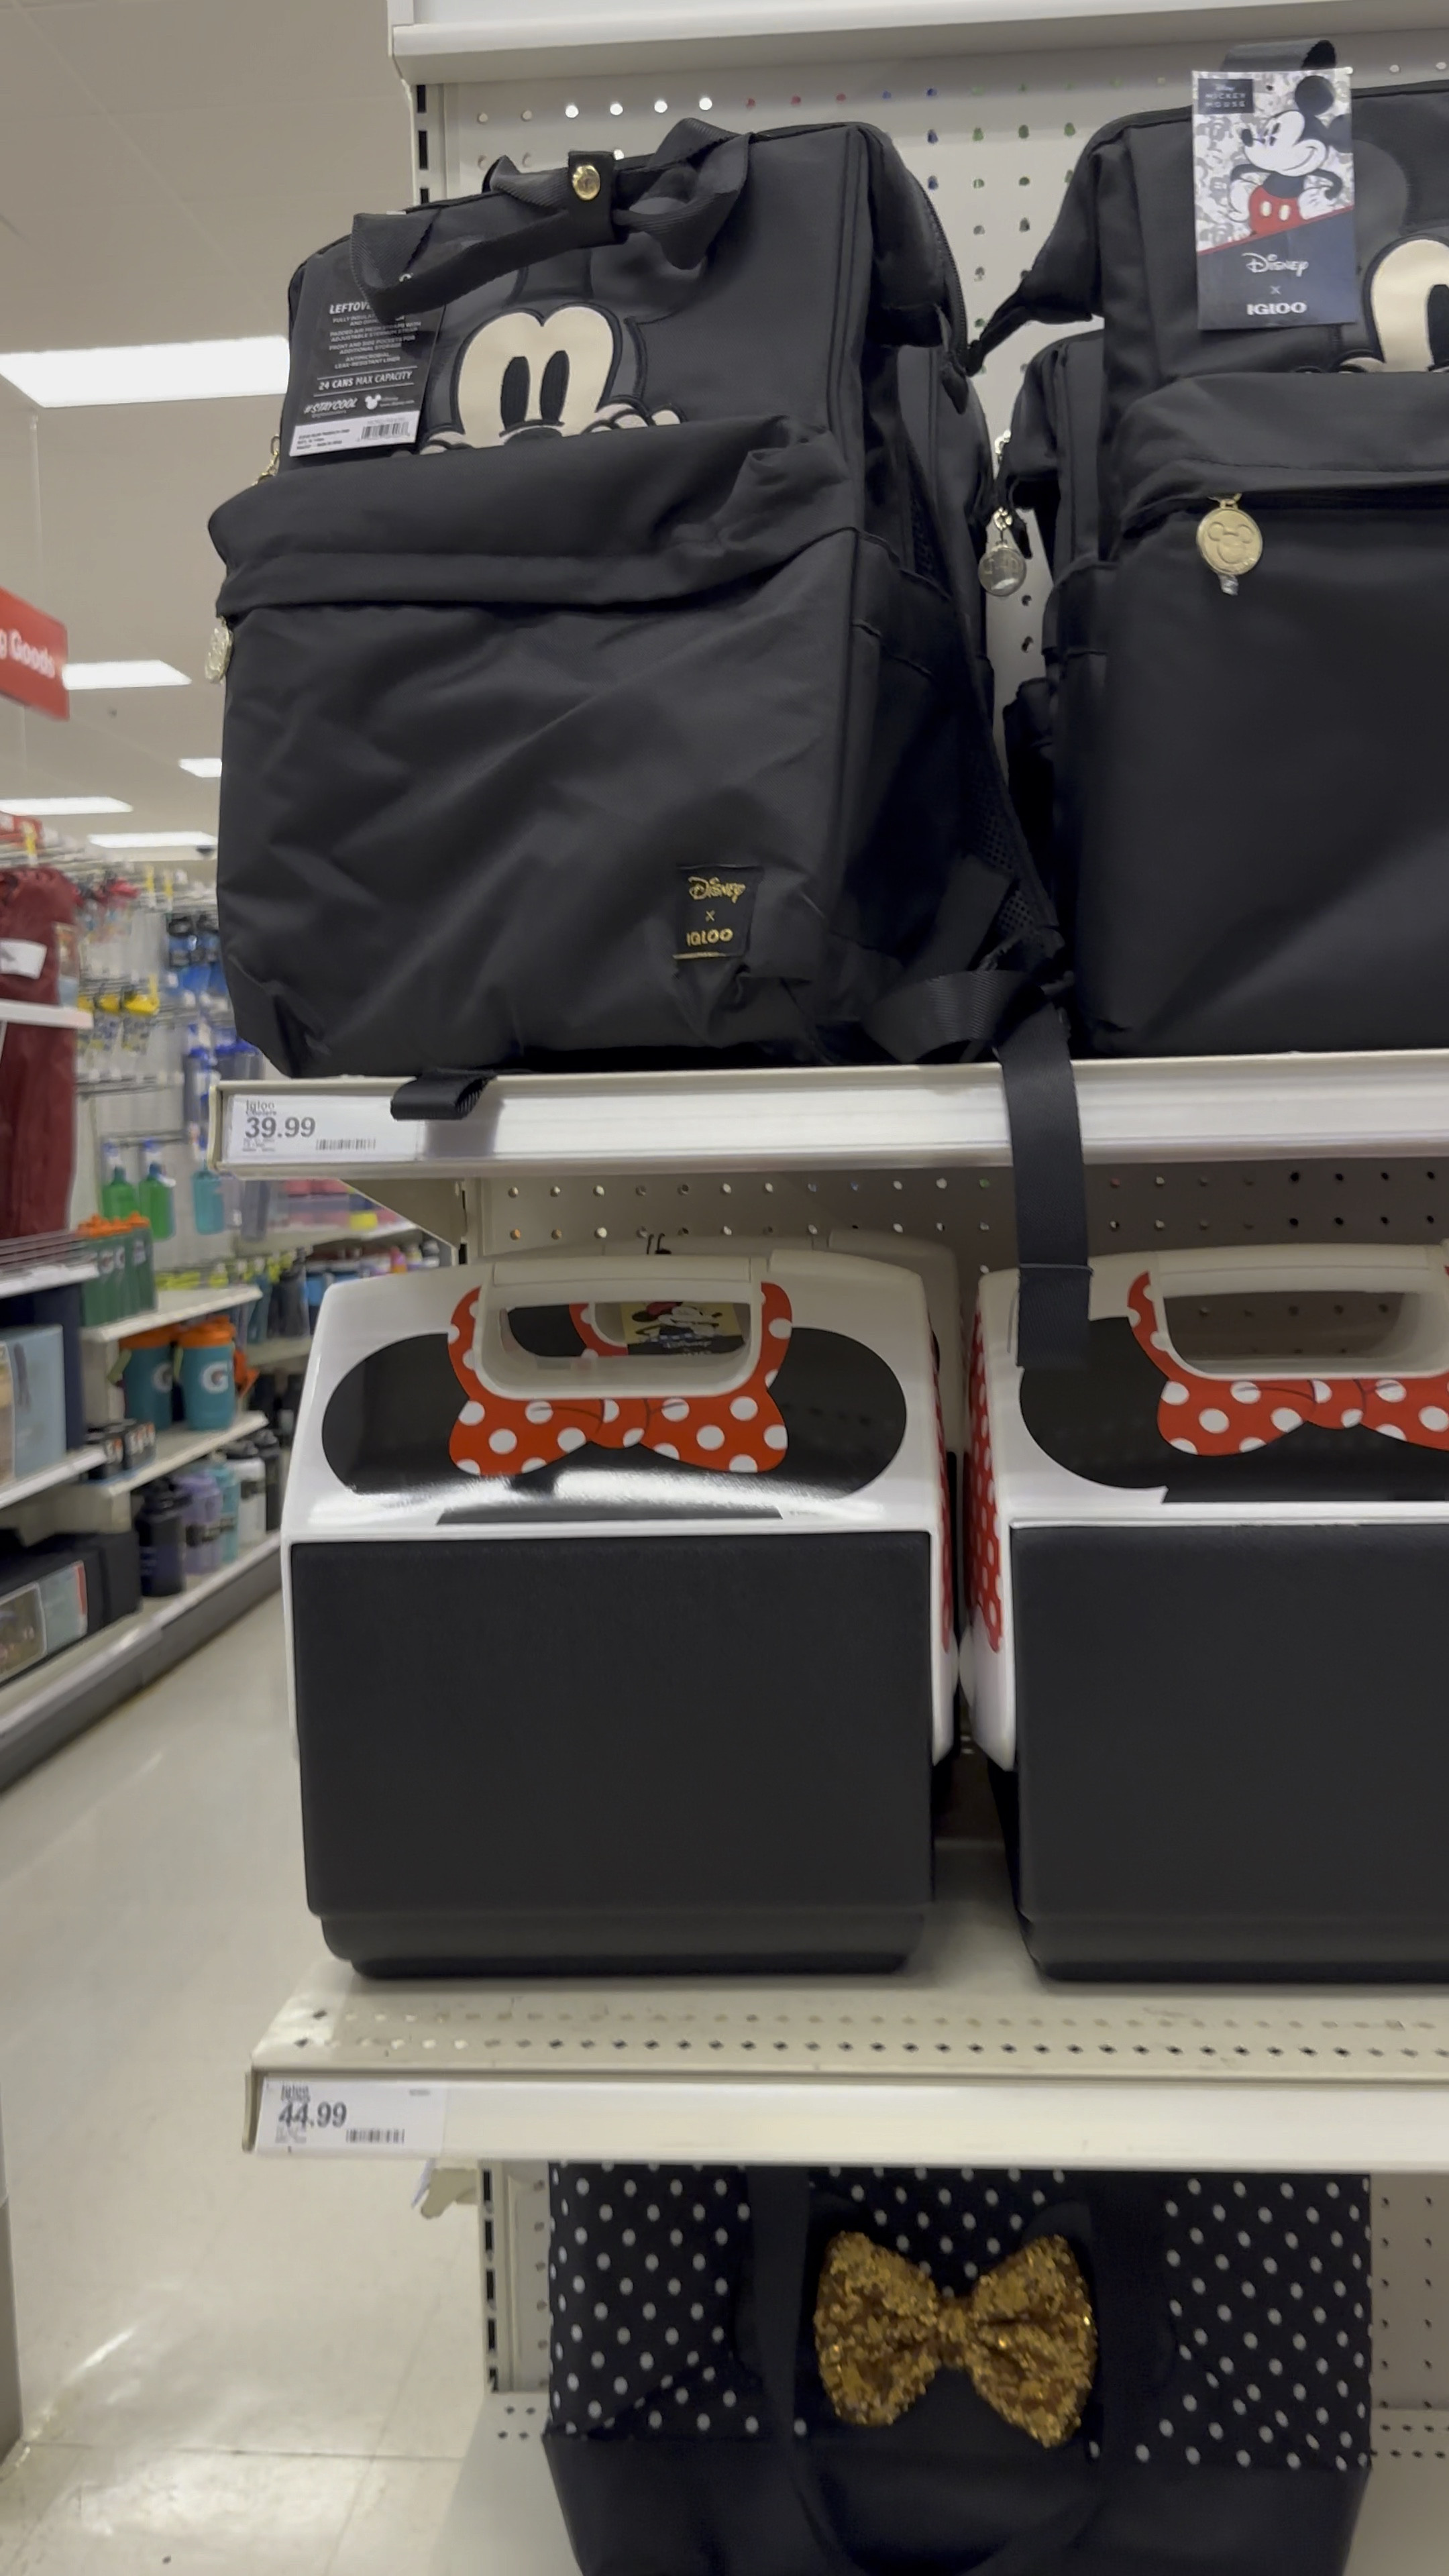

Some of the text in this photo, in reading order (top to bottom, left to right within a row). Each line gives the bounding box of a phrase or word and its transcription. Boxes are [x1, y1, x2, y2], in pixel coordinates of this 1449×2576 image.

[1241, 252, 1309, 276] Disney
[329, 302, 372, 315] LEFTOV
[1246, 301, 1307, 316] IGLOO
[319, 371, 413, 391] 24 CANS MAX CAPACITY
[686, 928, 733, 947] IGLOO
[245, 1116, 316, 1138] 39.99
[278, 2100, 347, 2129] 44.99
